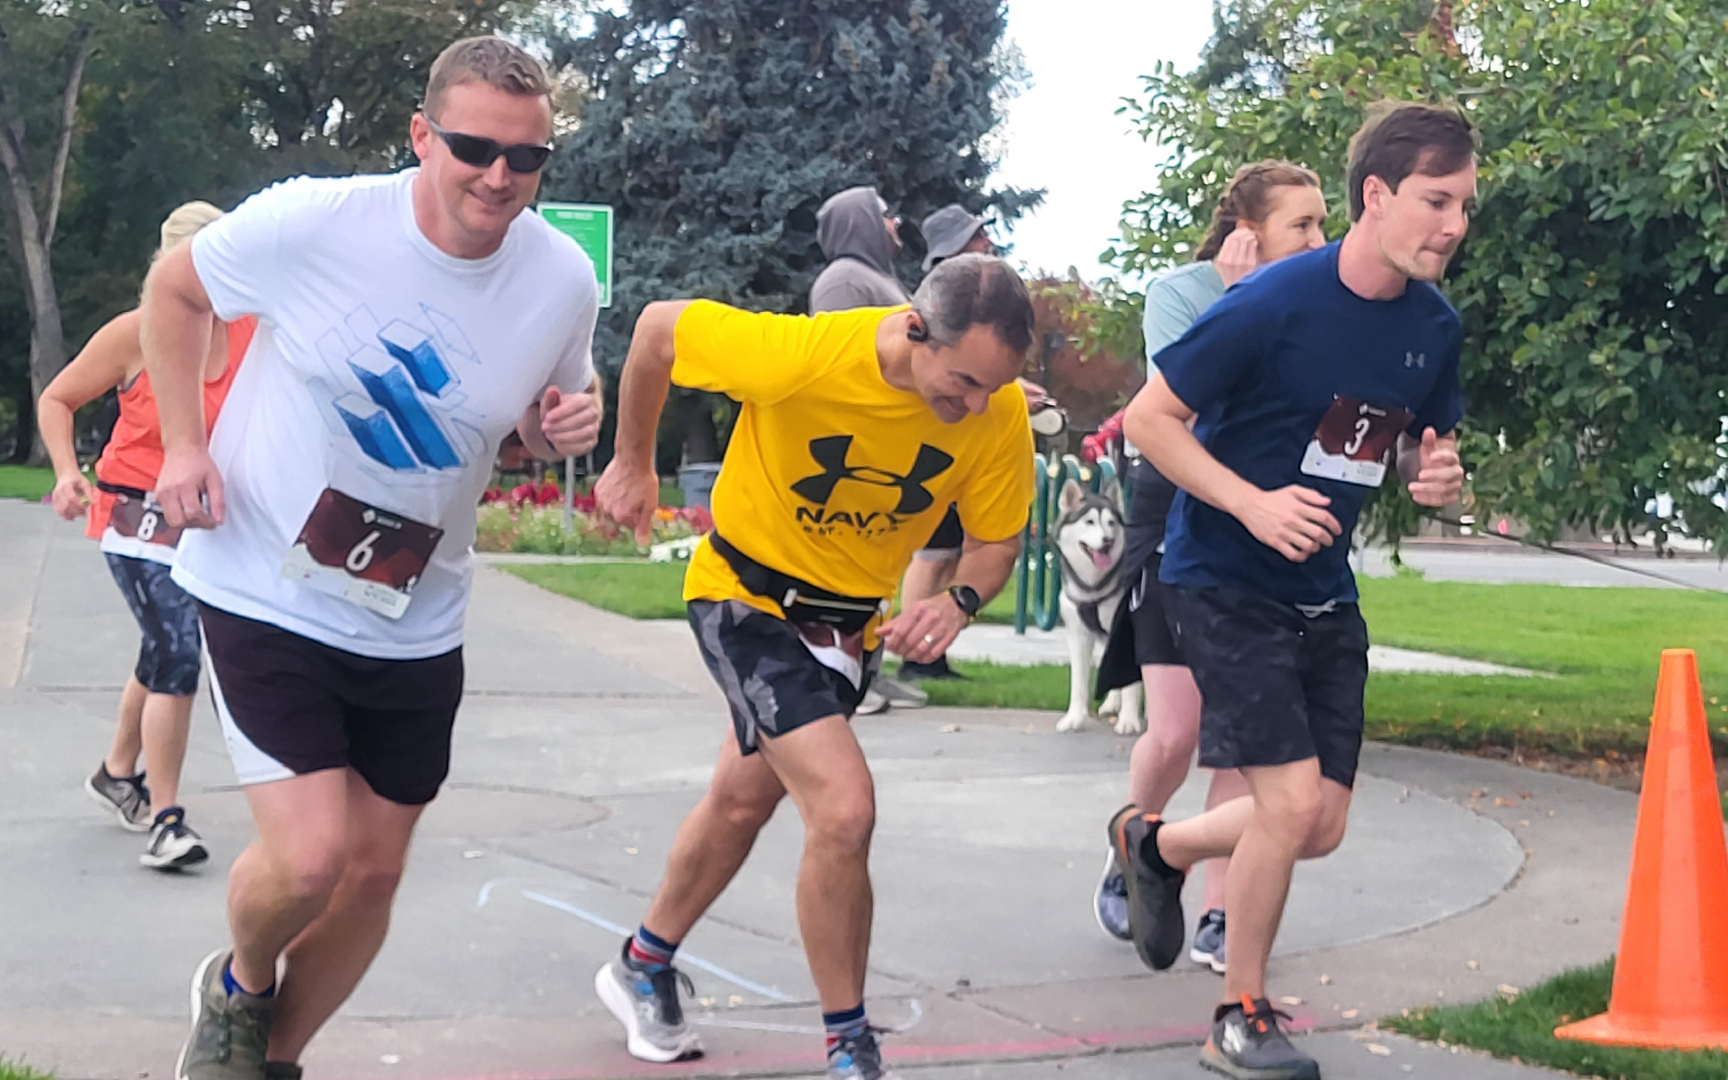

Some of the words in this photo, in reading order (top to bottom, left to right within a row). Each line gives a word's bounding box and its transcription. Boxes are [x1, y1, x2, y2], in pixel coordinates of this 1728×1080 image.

[1344, 418, 1370, 455] 3
[137, 511, 158, 541] 8
[796, 506, 910, 529] NAVY
[345, 529, 382, 573] 6
